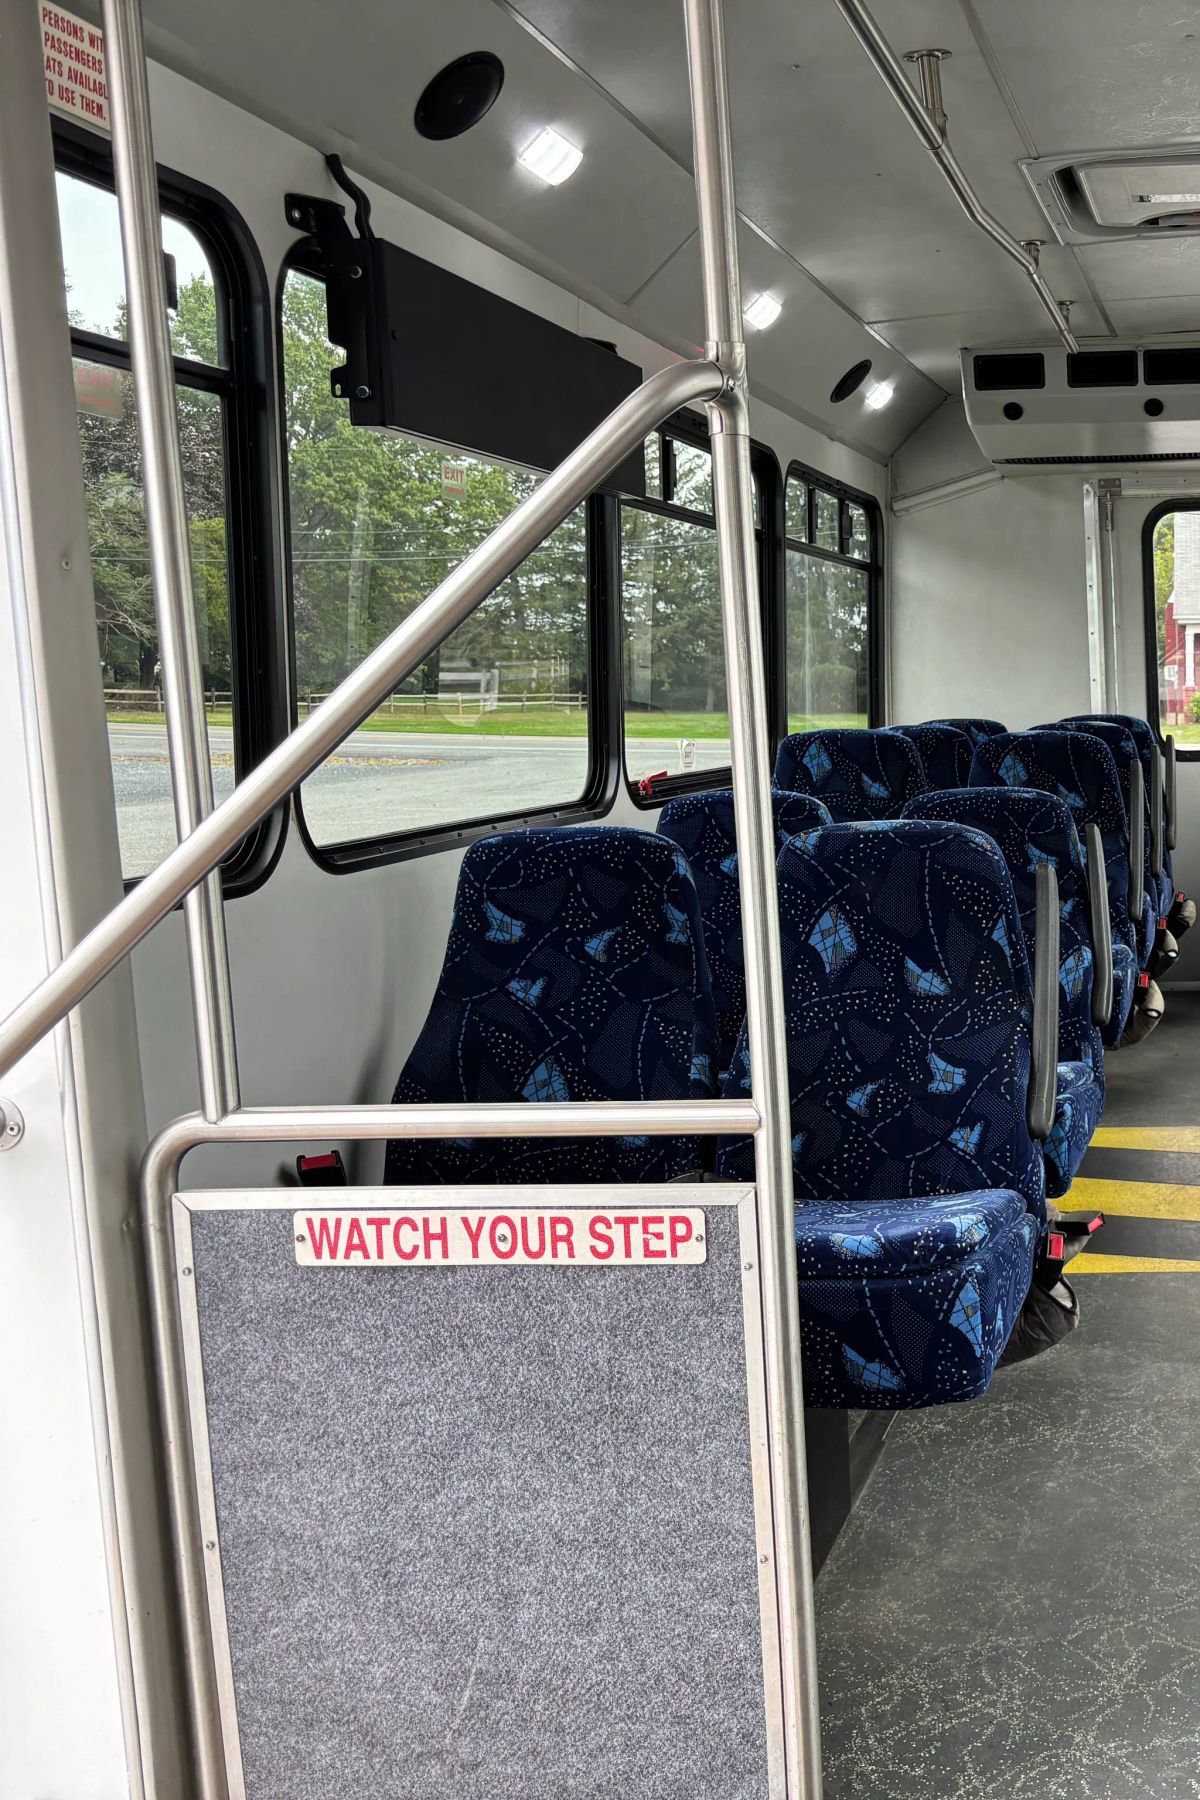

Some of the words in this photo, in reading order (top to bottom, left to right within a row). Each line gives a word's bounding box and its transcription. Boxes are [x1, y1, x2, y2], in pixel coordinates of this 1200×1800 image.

[42, 6, 85, 44] PERSONS
[88, 31, 104, 53] WIT
[44, 31, 103, 75] PASSENGERS
[46, 55, 63, 77] ATS
[67, 66, 109, 100] AVAILABL
[58, 84, 76, 106] USE
[79, 94, 106, 120] THEM.
[444, 465, 464, 483] EXIT
[306, 1216, 449, 1260] WATCH
[461, 1214, 576, 1260] YOUR
[588, 1214, 693, 1260] STEP
